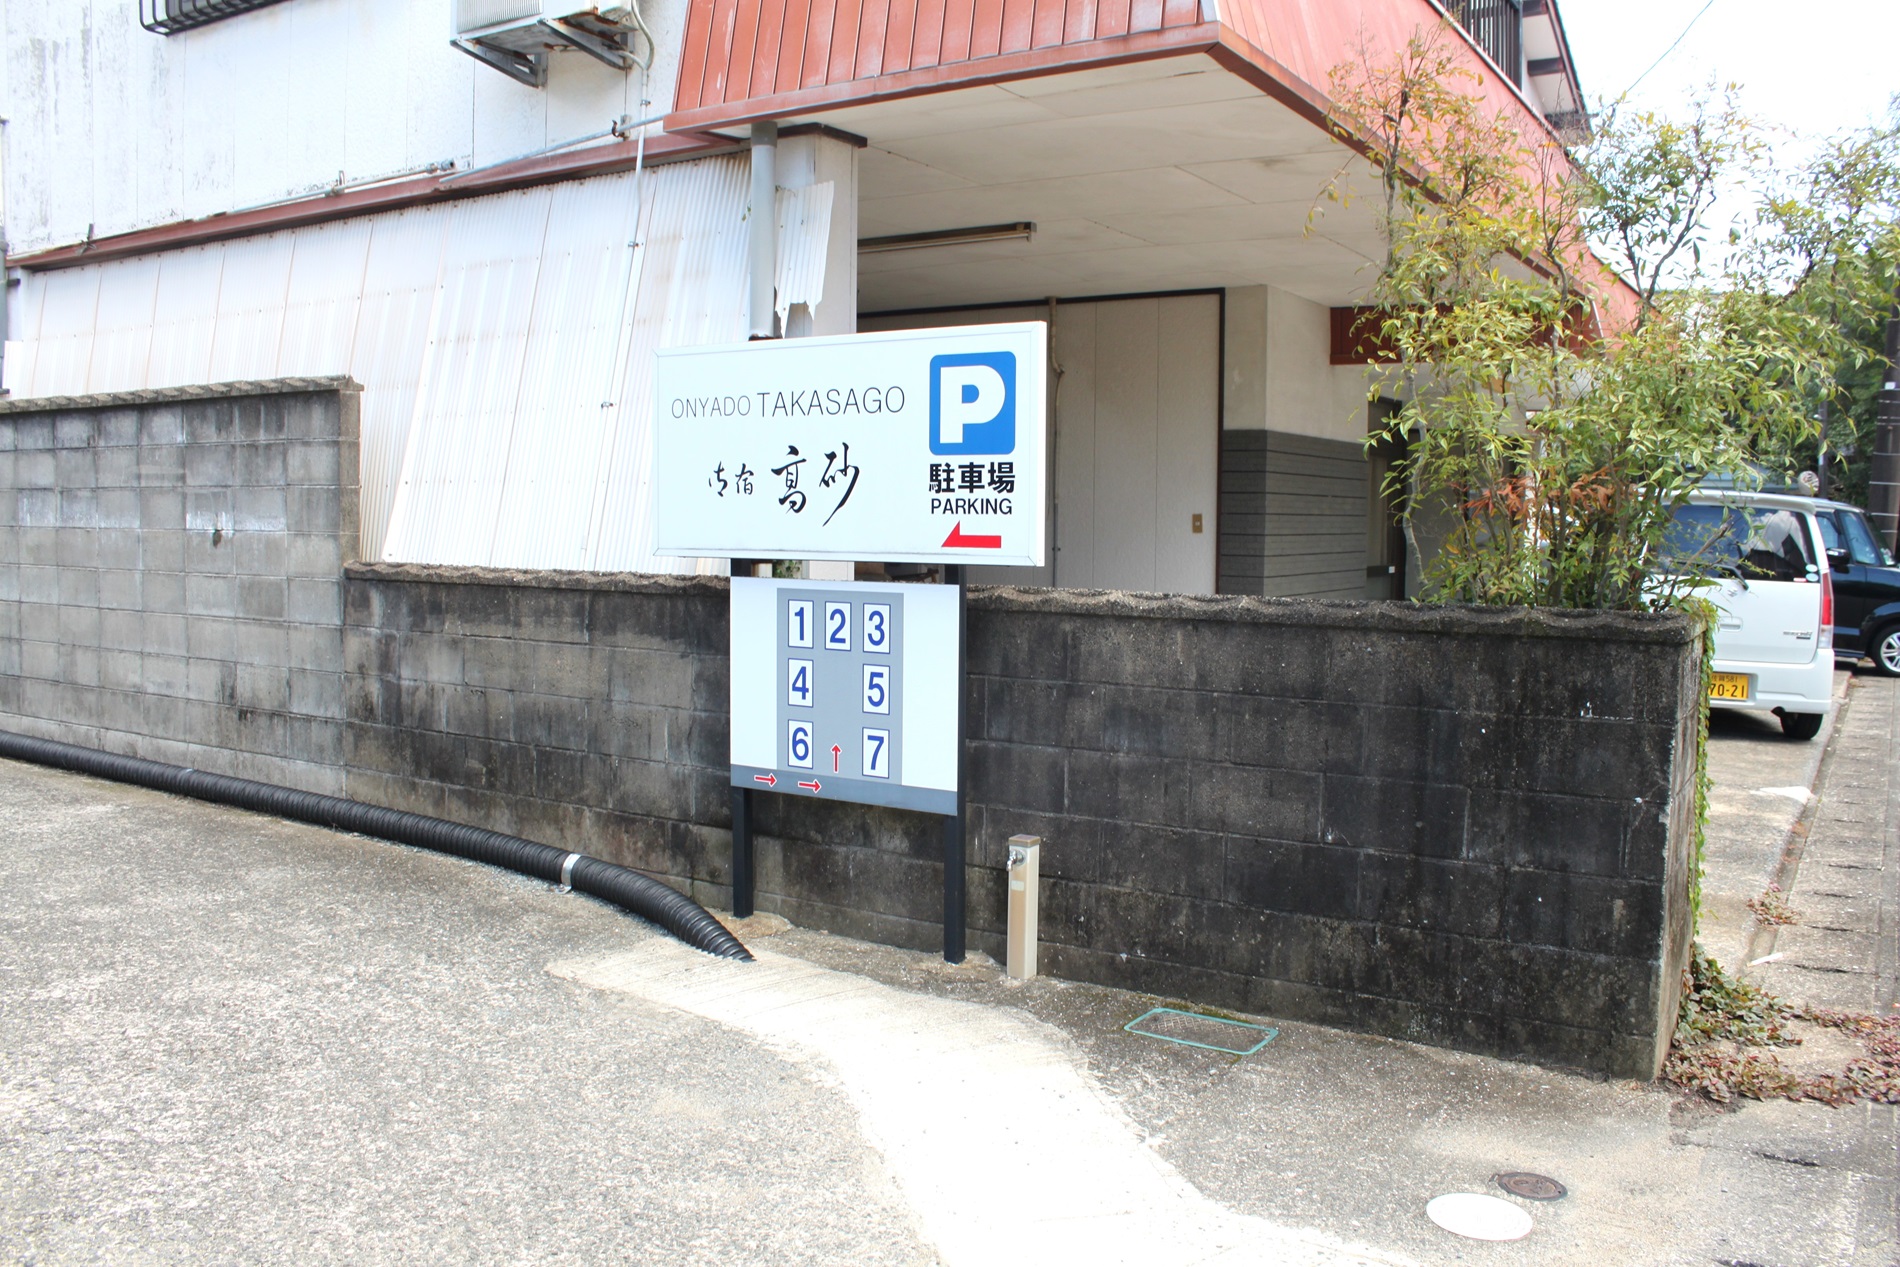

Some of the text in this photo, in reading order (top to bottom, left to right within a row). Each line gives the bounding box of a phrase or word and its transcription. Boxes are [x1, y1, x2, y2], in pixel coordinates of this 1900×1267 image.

[672, 386, 905, 418] ONYADO TAKASAGO
[940, 365, 1006, 443] P
[771, 442, 860, 527] 高砂
[929, 462, 1015, 493] 駐車場
[931, 498, 1012, 515] PARKING
[794, 607, 885, 646] 1 2 3
[791, 666, 885, 707] 4 5
[791, 727, 884, 770] 6 7
